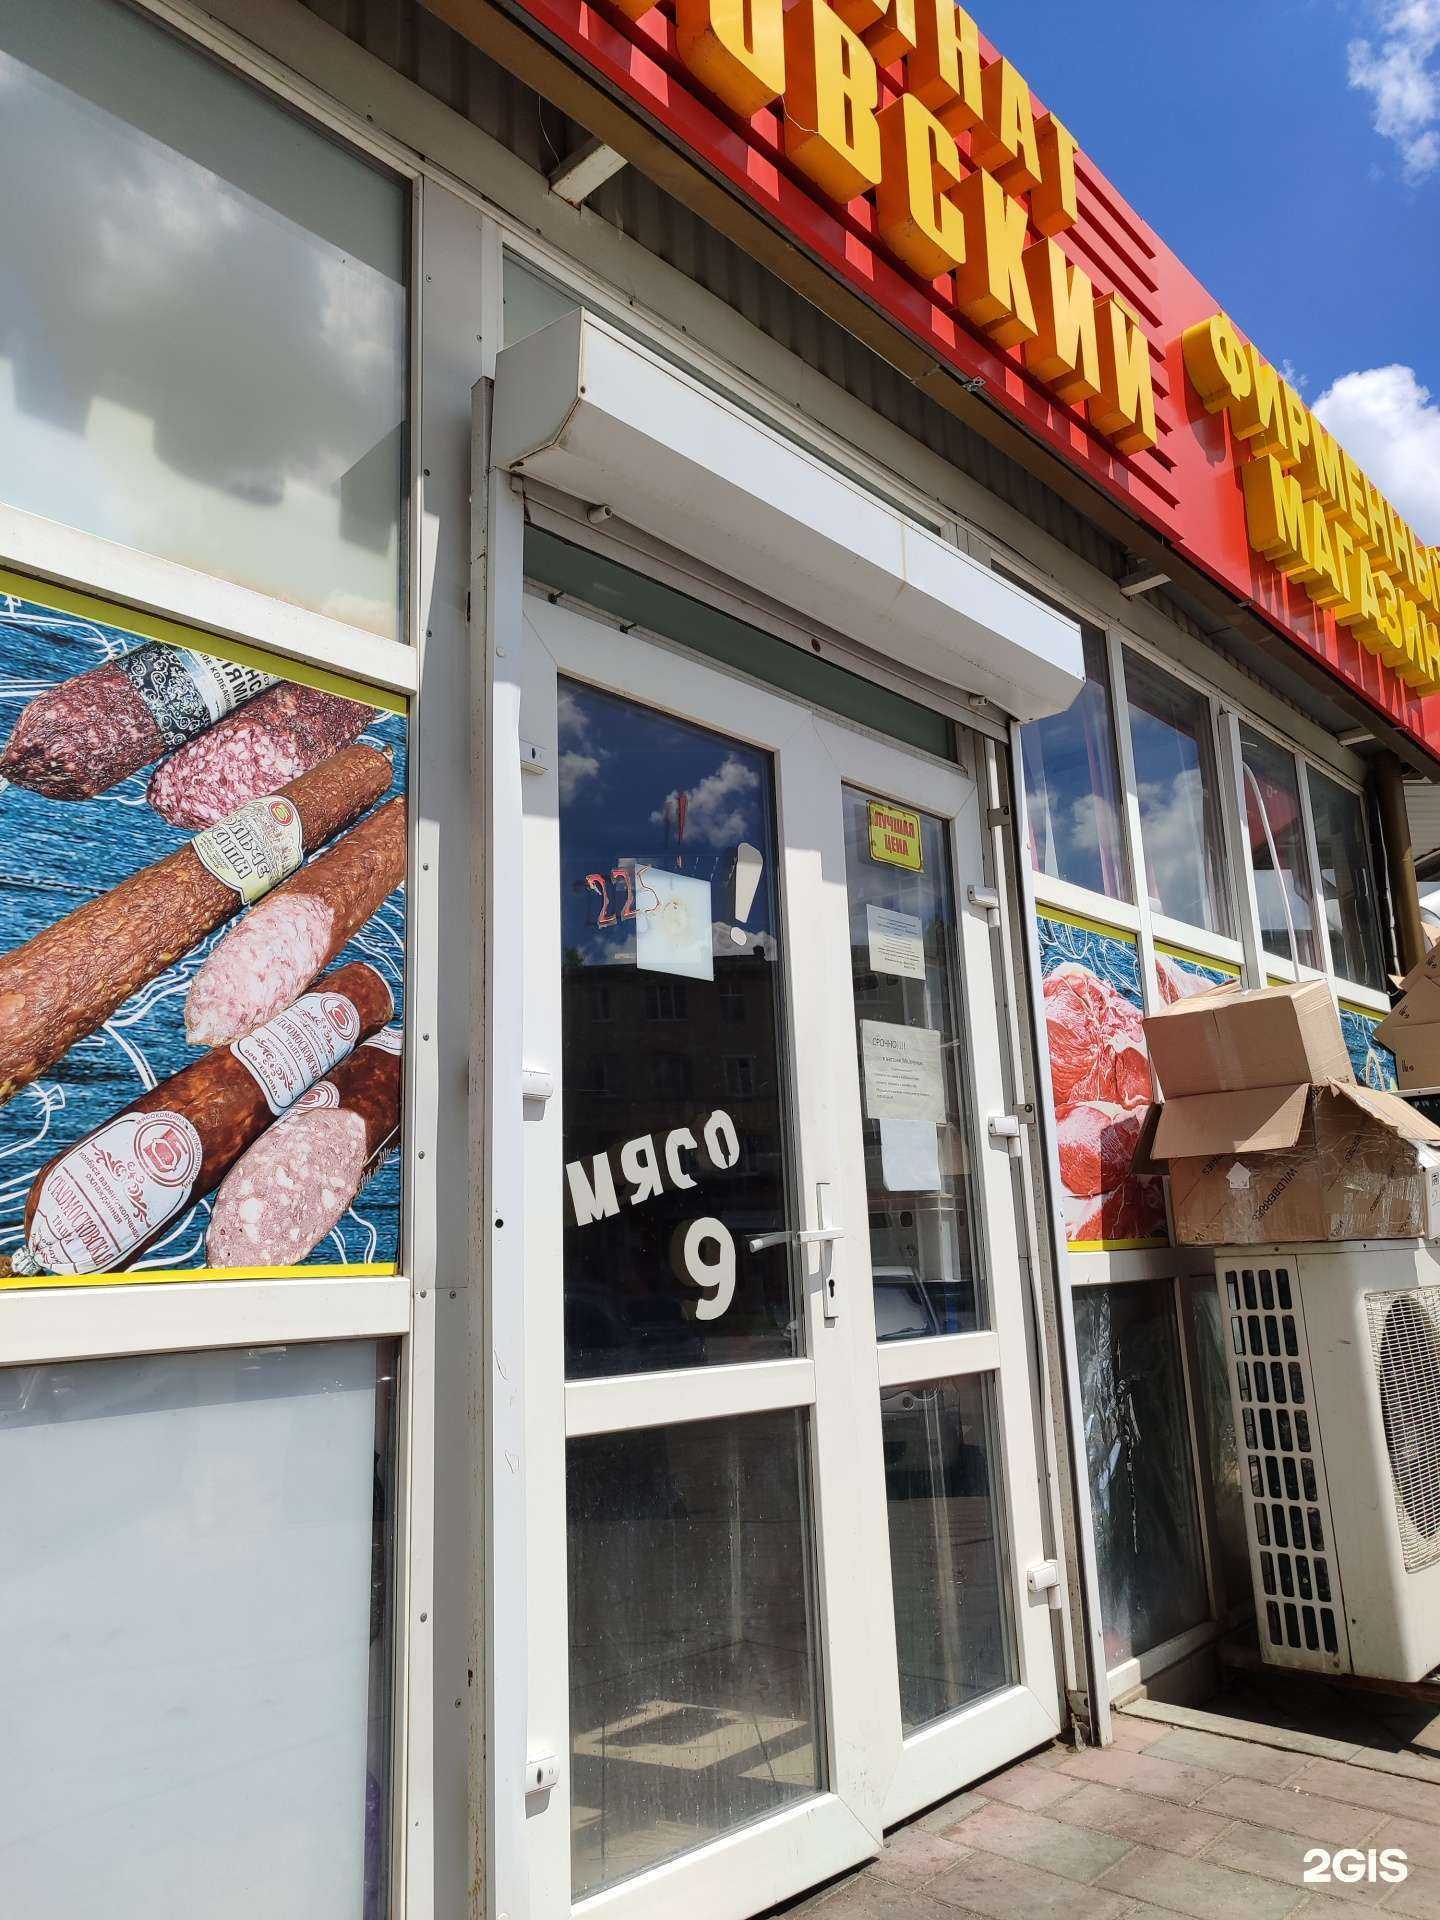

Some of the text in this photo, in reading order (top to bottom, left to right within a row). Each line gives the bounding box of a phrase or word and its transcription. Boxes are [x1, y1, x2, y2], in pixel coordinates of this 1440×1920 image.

[884, 833, 910, 857] ЦЕНА
[566, 1109, 740, 1227] МЯСО
[1252, 1167, 1299, 1222] WILDBERRIES
[684, 1216, 736, 1321] 9
